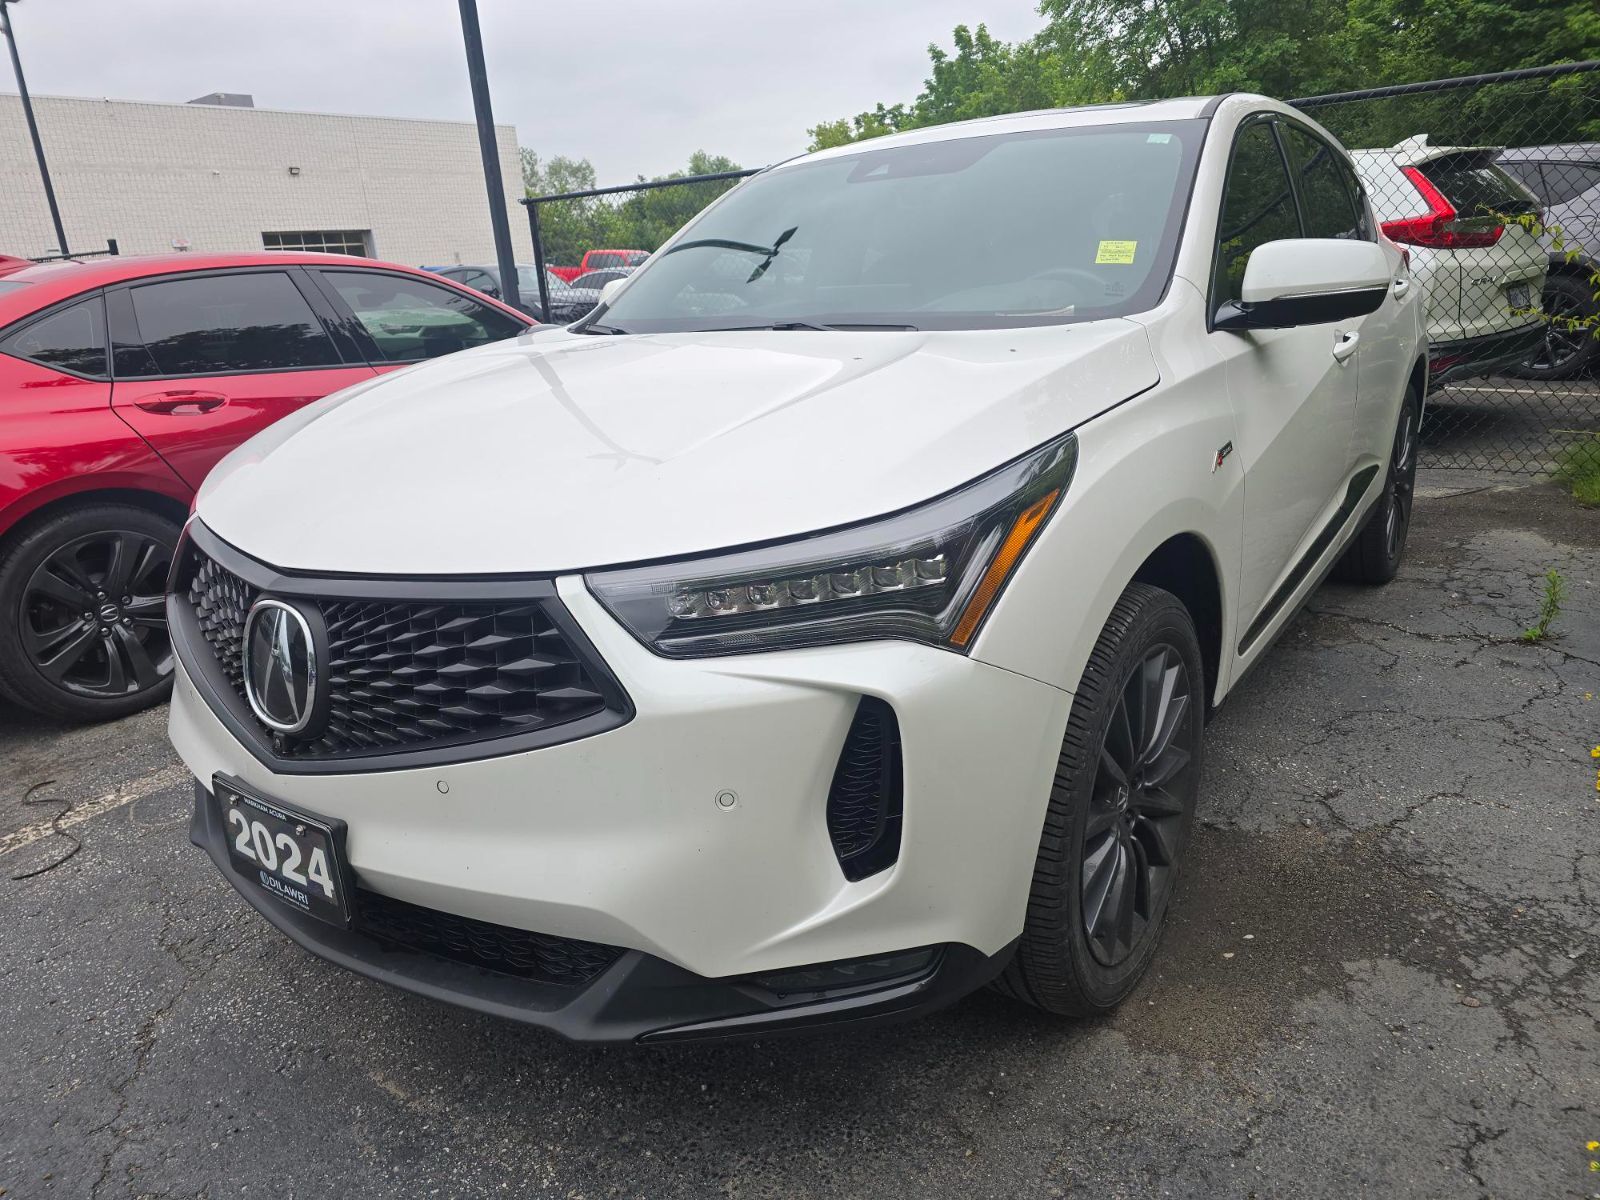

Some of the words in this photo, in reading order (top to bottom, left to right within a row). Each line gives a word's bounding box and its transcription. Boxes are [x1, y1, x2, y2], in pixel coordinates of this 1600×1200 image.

[269, 808, 287, 822] ACURA
[229, 808, 335, 898] 2024
[268, 876, 309, 905] DILAWRI
